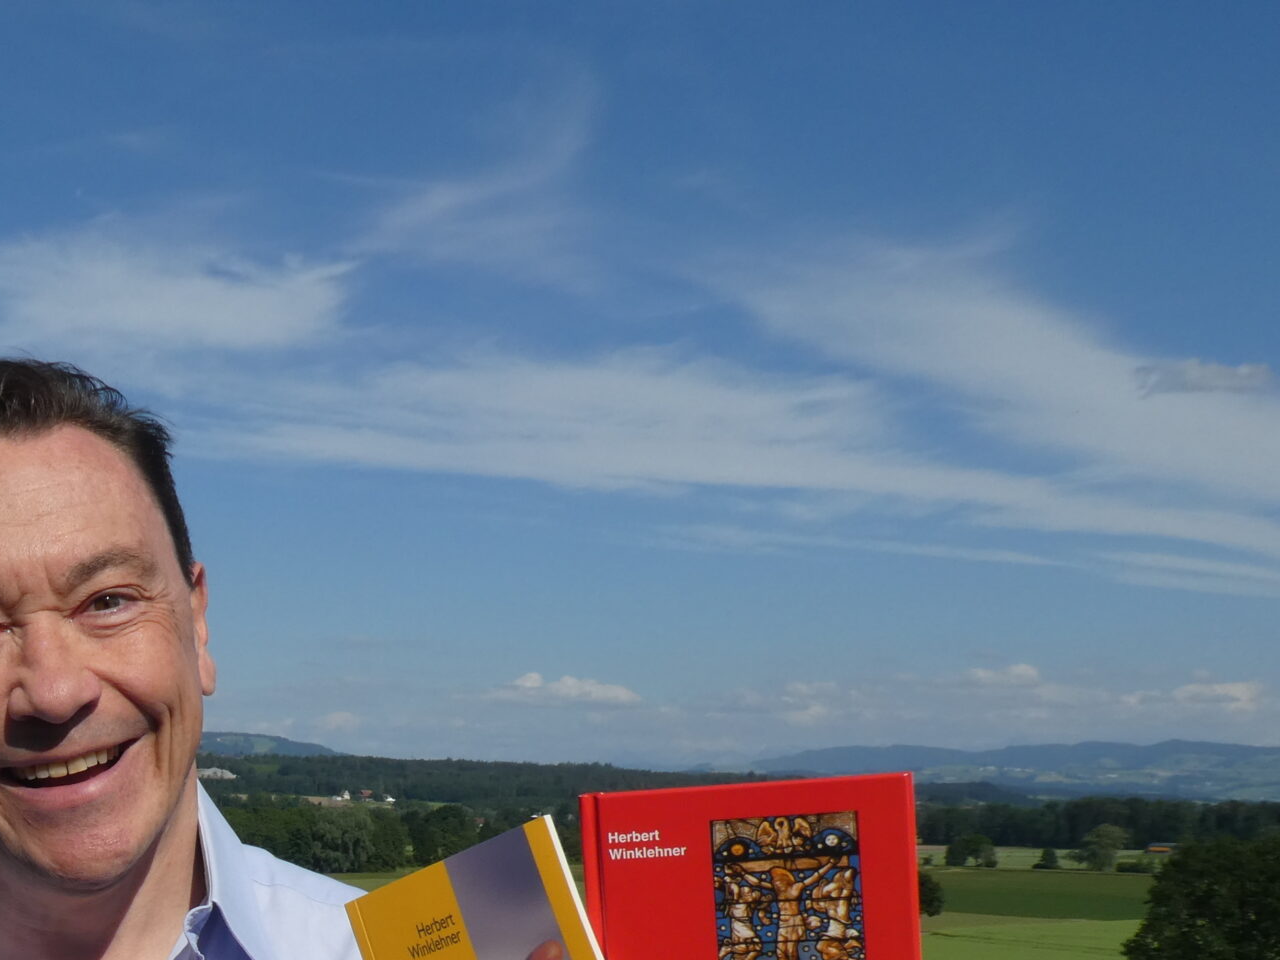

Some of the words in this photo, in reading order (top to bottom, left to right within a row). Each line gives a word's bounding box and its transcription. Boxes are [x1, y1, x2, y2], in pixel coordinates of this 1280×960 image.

[608, 829, 660, 844] Herbert
[608, 845, 687, 861] Winklehner
[416, 914, 455, 939] Herbert
[407, 930, 461, 960] Winklehner
